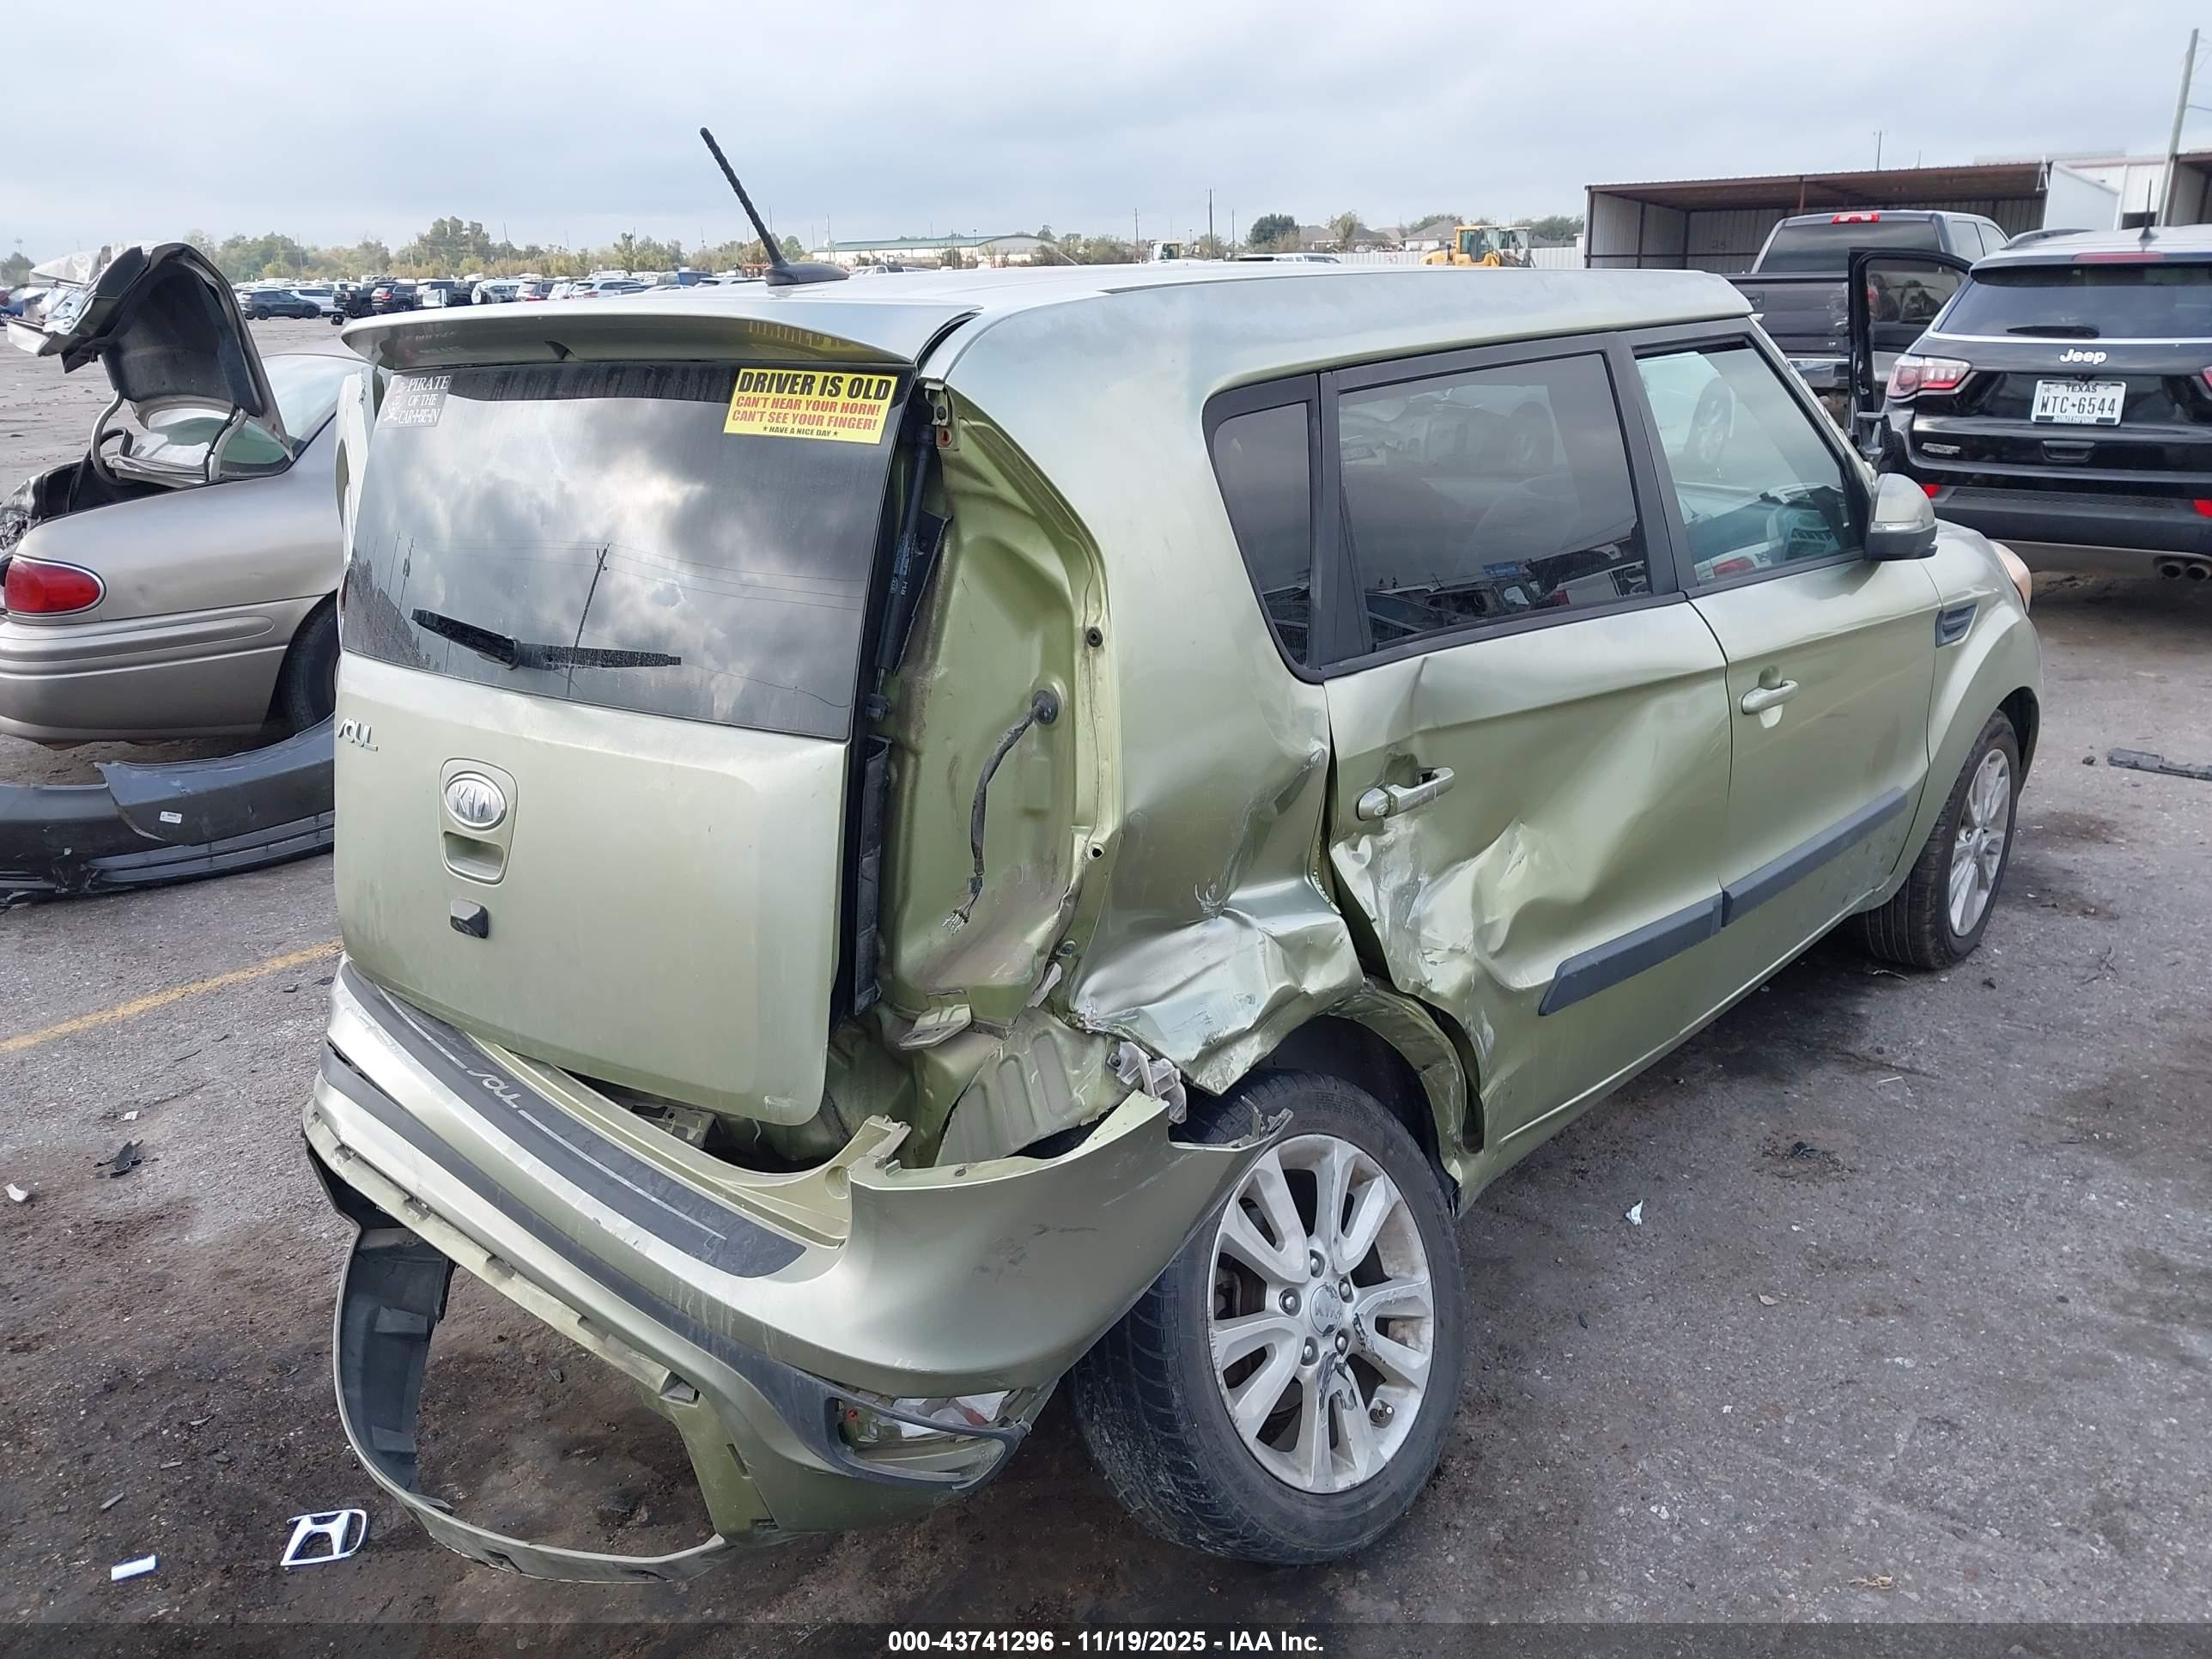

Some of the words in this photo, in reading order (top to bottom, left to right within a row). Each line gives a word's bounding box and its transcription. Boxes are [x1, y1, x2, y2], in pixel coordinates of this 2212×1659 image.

[2059, 348, 2107, 366] Jeep
[406, 375, 452, 392] PIRATE
[738, 371, 817, 396] DRIVER
[818, 375, 844, 398] IS
[848, 377, 892, 400] OLD
[2065, 384, 2098, 393] TEXAS
[408, 394, 421, 406] OF
[420, 393, 439, 406] THE
[736, 396, 770, 410] CAN'T
[770, 398, 803, 411] HEAR
[805, 399, 838, 413] YOUR
[840, 402, 882, 416] HORN!
[732, 410, 766, 422] CAN'T
[767, 411, 789, 424] SEE
[792, 413, 824, 427] YOUR
[827, 416, 878, 431] FINGER!
[769, 426, 789, 434] HAVE
[796, 428, 815, 436] NICE
[453, 783, 494, 821] KIA
[466, 1070, 521, 1109] SOUL
